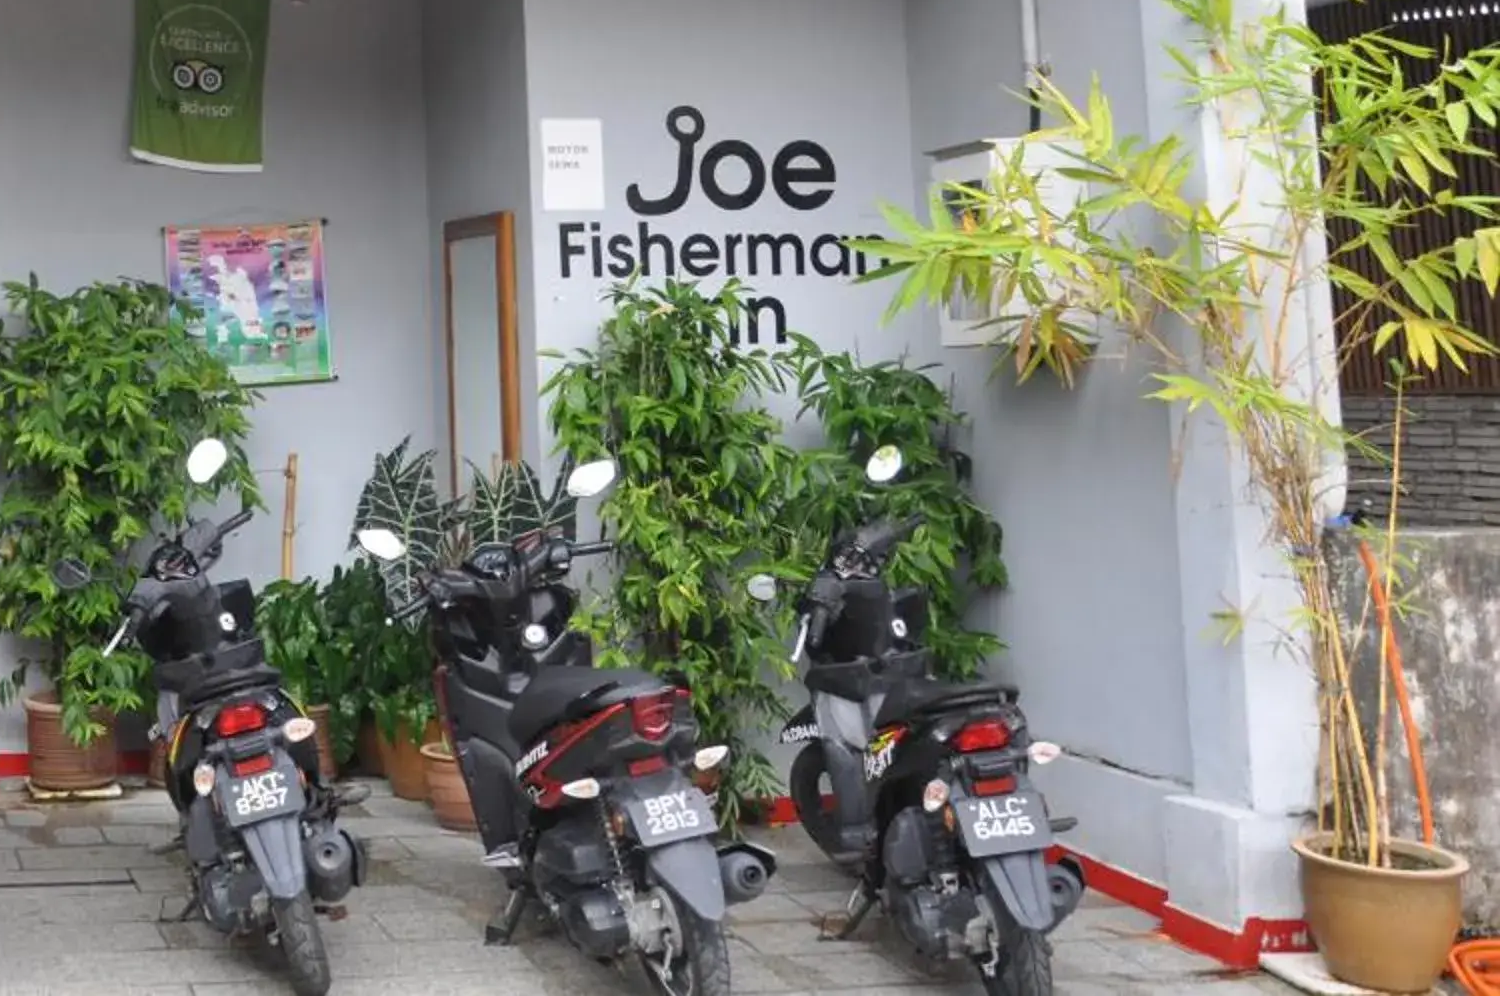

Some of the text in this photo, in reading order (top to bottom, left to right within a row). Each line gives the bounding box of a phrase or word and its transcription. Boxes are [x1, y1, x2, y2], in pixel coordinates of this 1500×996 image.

[625, 105, 837, 216] Joe
[241, 771, 279, 797] AKT
[235, 788, 289, 815] 8357
[643, 790, 688, 816] BPY
[978, 797, 1023, 821] ALC
[646, 809, 700, 835] 2813
[972, 815, 1036, 840] 6445
